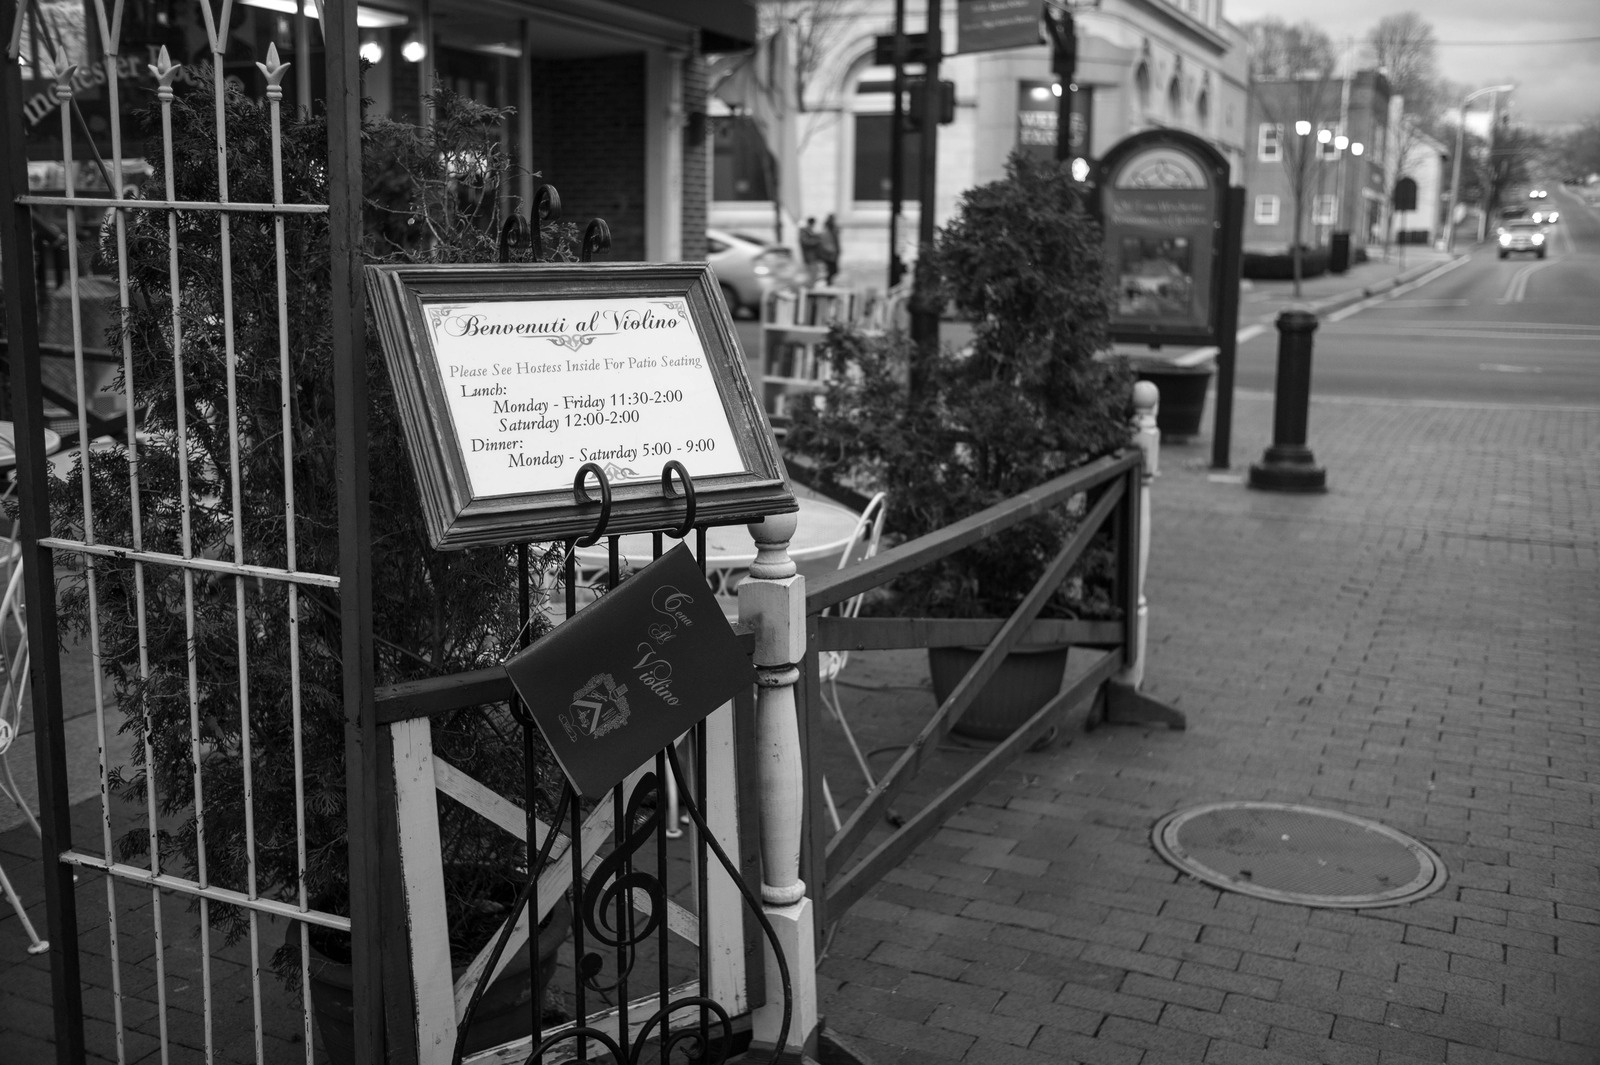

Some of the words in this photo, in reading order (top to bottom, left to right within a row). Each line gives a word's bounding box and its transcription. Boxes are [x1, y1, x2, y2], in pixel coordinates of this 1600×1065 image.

[444, 314, 569, 337] Benvenuti
[576, 310, 600, 332] al
[602, 309, 680, 331] Violino
[449, 365, 488, 378] Please
[492, 363, 512, 376] See
[516, 361, 562, 374] Hostess
[566, 359, 601, 372] Inside
[603, 358, 625, 370] For
[627, 356, 657, 369] Patio
[661, 354, 703, 369] Seating
[460, 383, 507, 397] Lunch:
[493, 398, 549, 415] Monday
[562, 394, 606, 411] Friday
[610, 389, 683, 406] 11:30-2:00
[498, 415, 560, 433] Saturday
[564, 409, 640, 427] 12:00-2:00
[470, 438, 523, 453] Dinner:
[508, 451, 564, 469] Monday
[579, 445, 638, 462] Saturday
[642, 441, 672, 457] 5:00
[685, 438, 715, 453] 9:00
[632, 642, 681, 707] Violino
